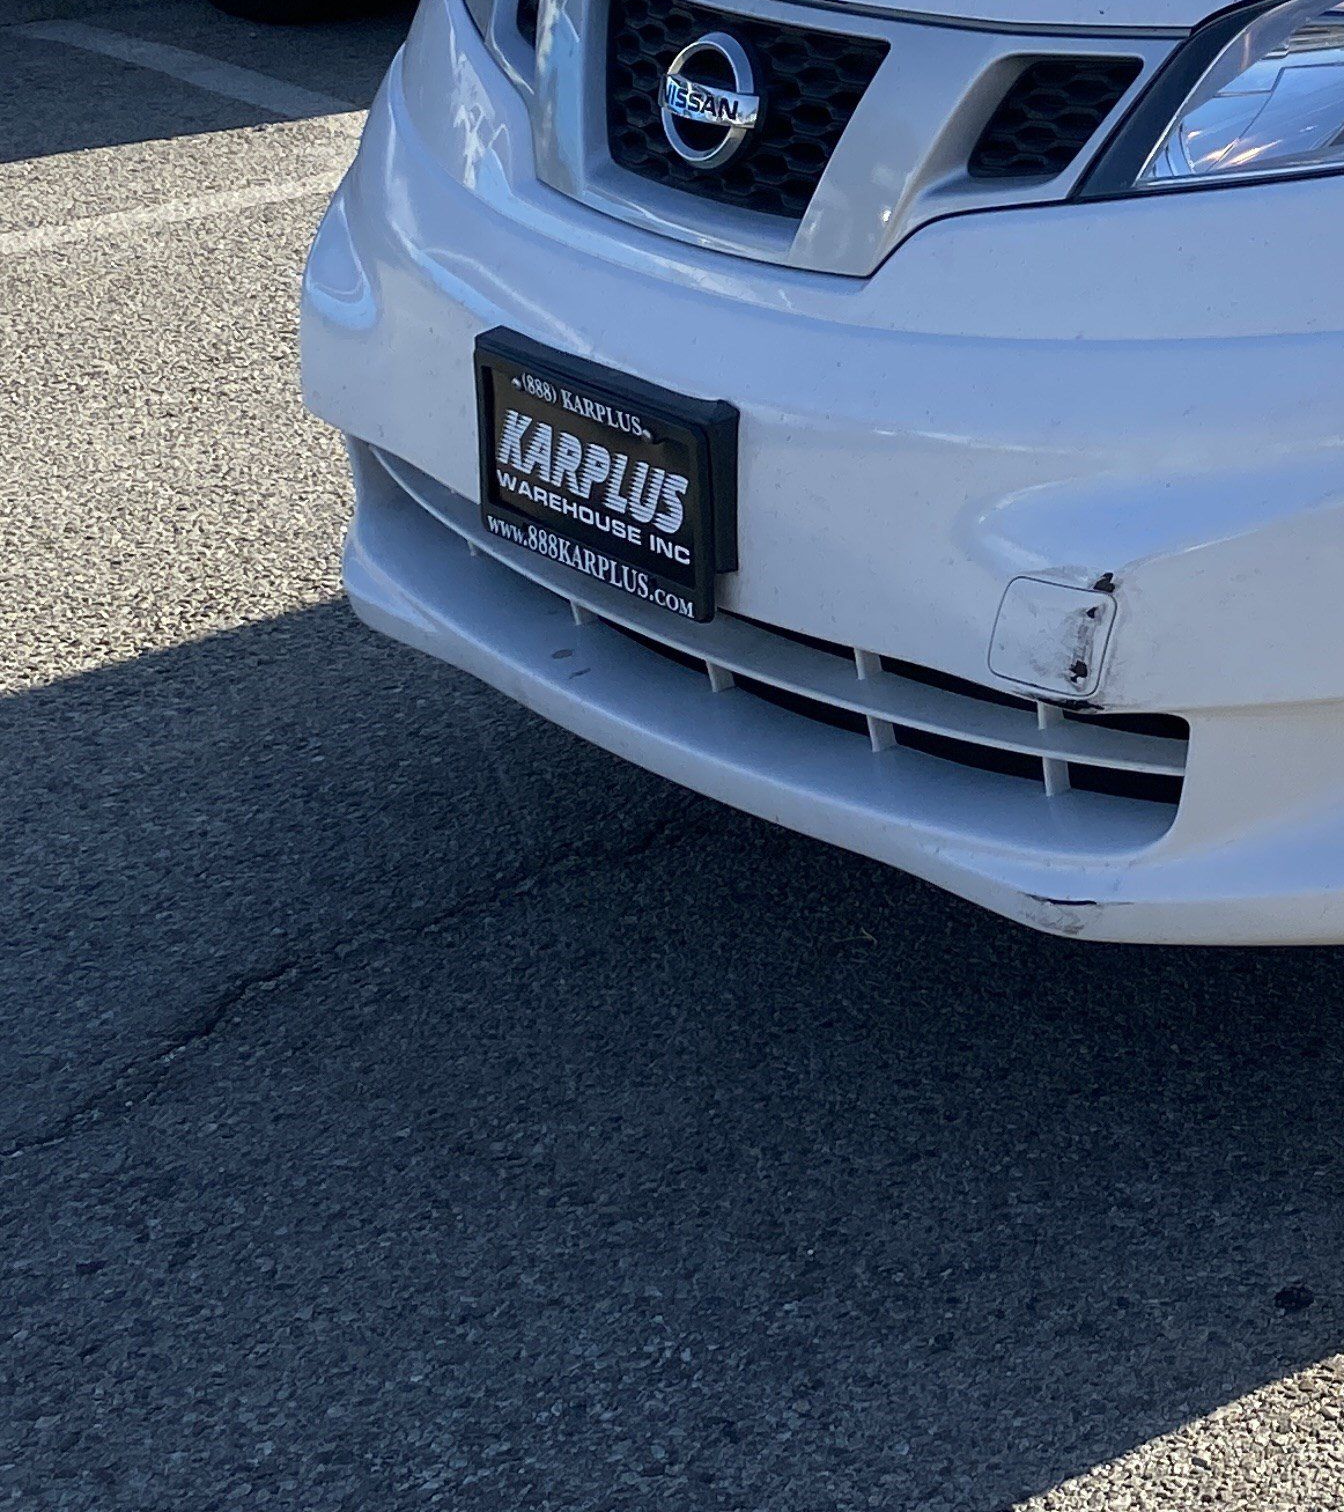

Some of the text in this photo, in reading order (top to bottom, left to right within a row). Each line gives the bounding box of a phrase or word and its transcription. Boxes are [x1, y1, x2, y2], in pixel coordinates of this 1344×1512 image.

[665, 83, 739, 120] NISSAN
[521, 372, 642, 436] (888) KARPLUS
[496, 407, 689, 534] KARPLUS
[497, 469, 690, 565] WAREHOUSE INC
